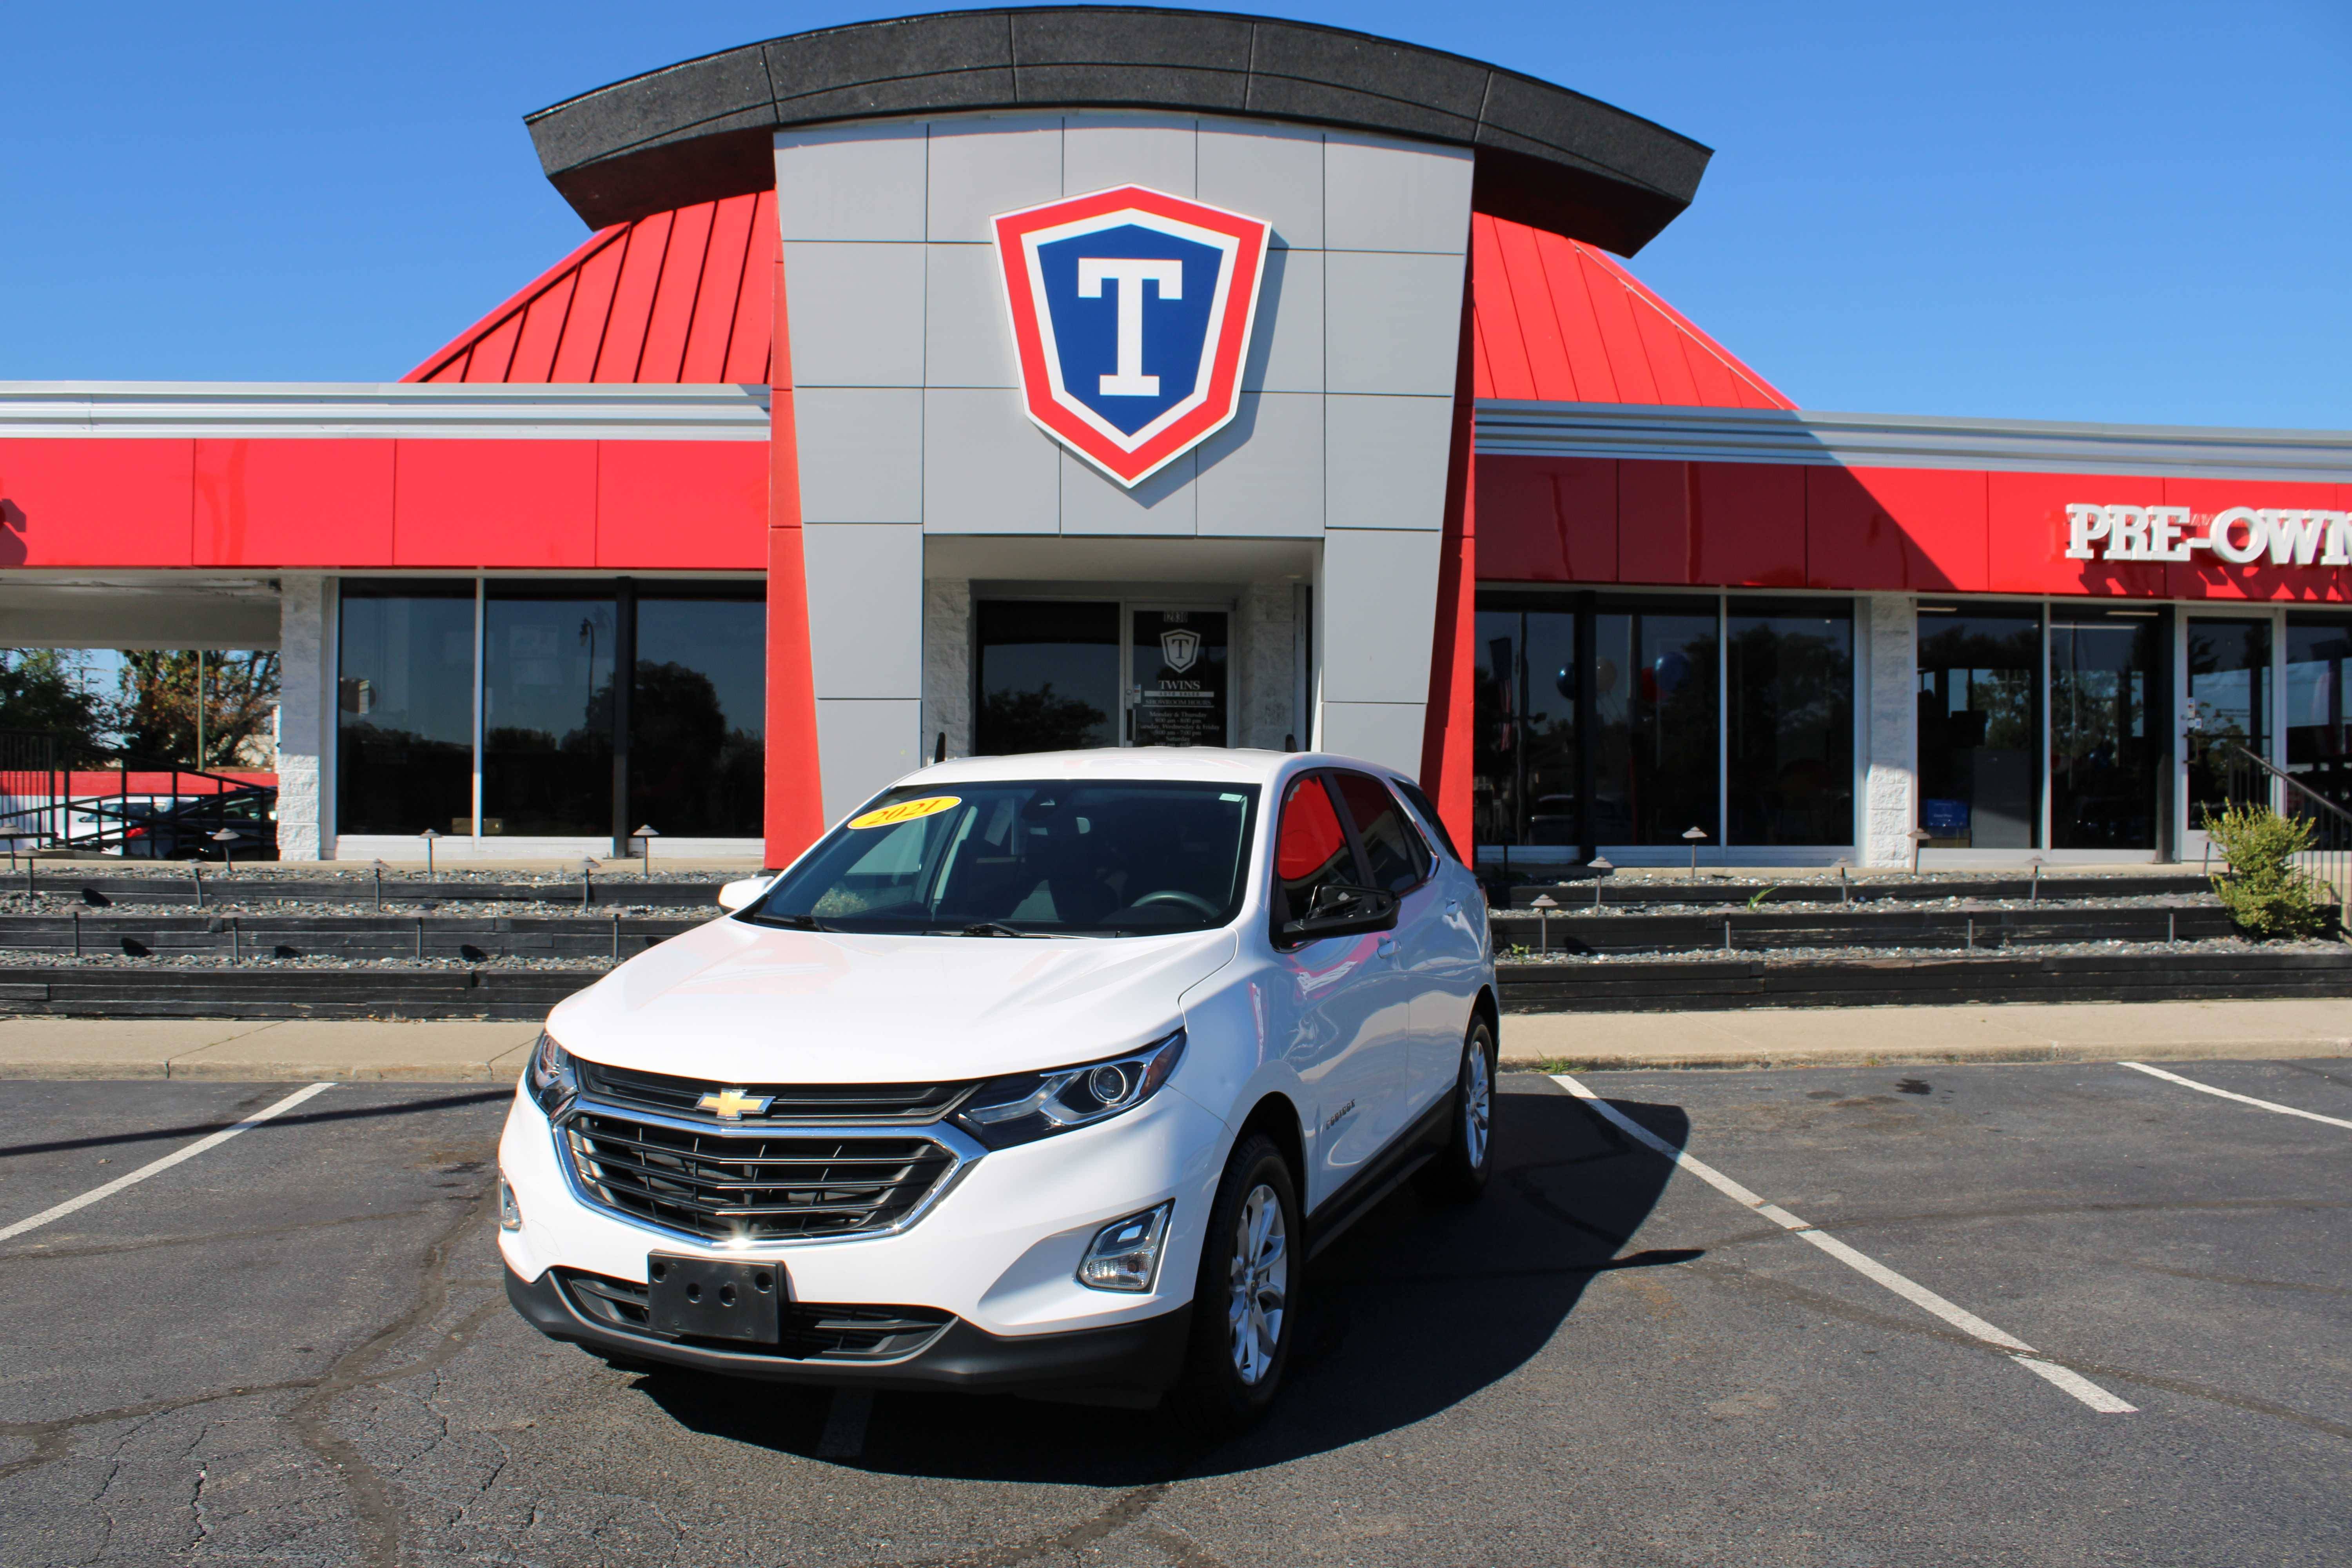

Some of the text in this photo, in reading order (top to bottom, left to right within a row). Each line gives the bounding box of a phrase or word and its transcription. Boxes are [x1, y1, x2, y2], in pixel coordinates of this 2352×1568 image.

[1078, 257, 1182, 396] T
[1172, 639, 1189, 659] T
[1158, 680, 1200, 690] TWINS
[866, 799, 942, 825] 2021
